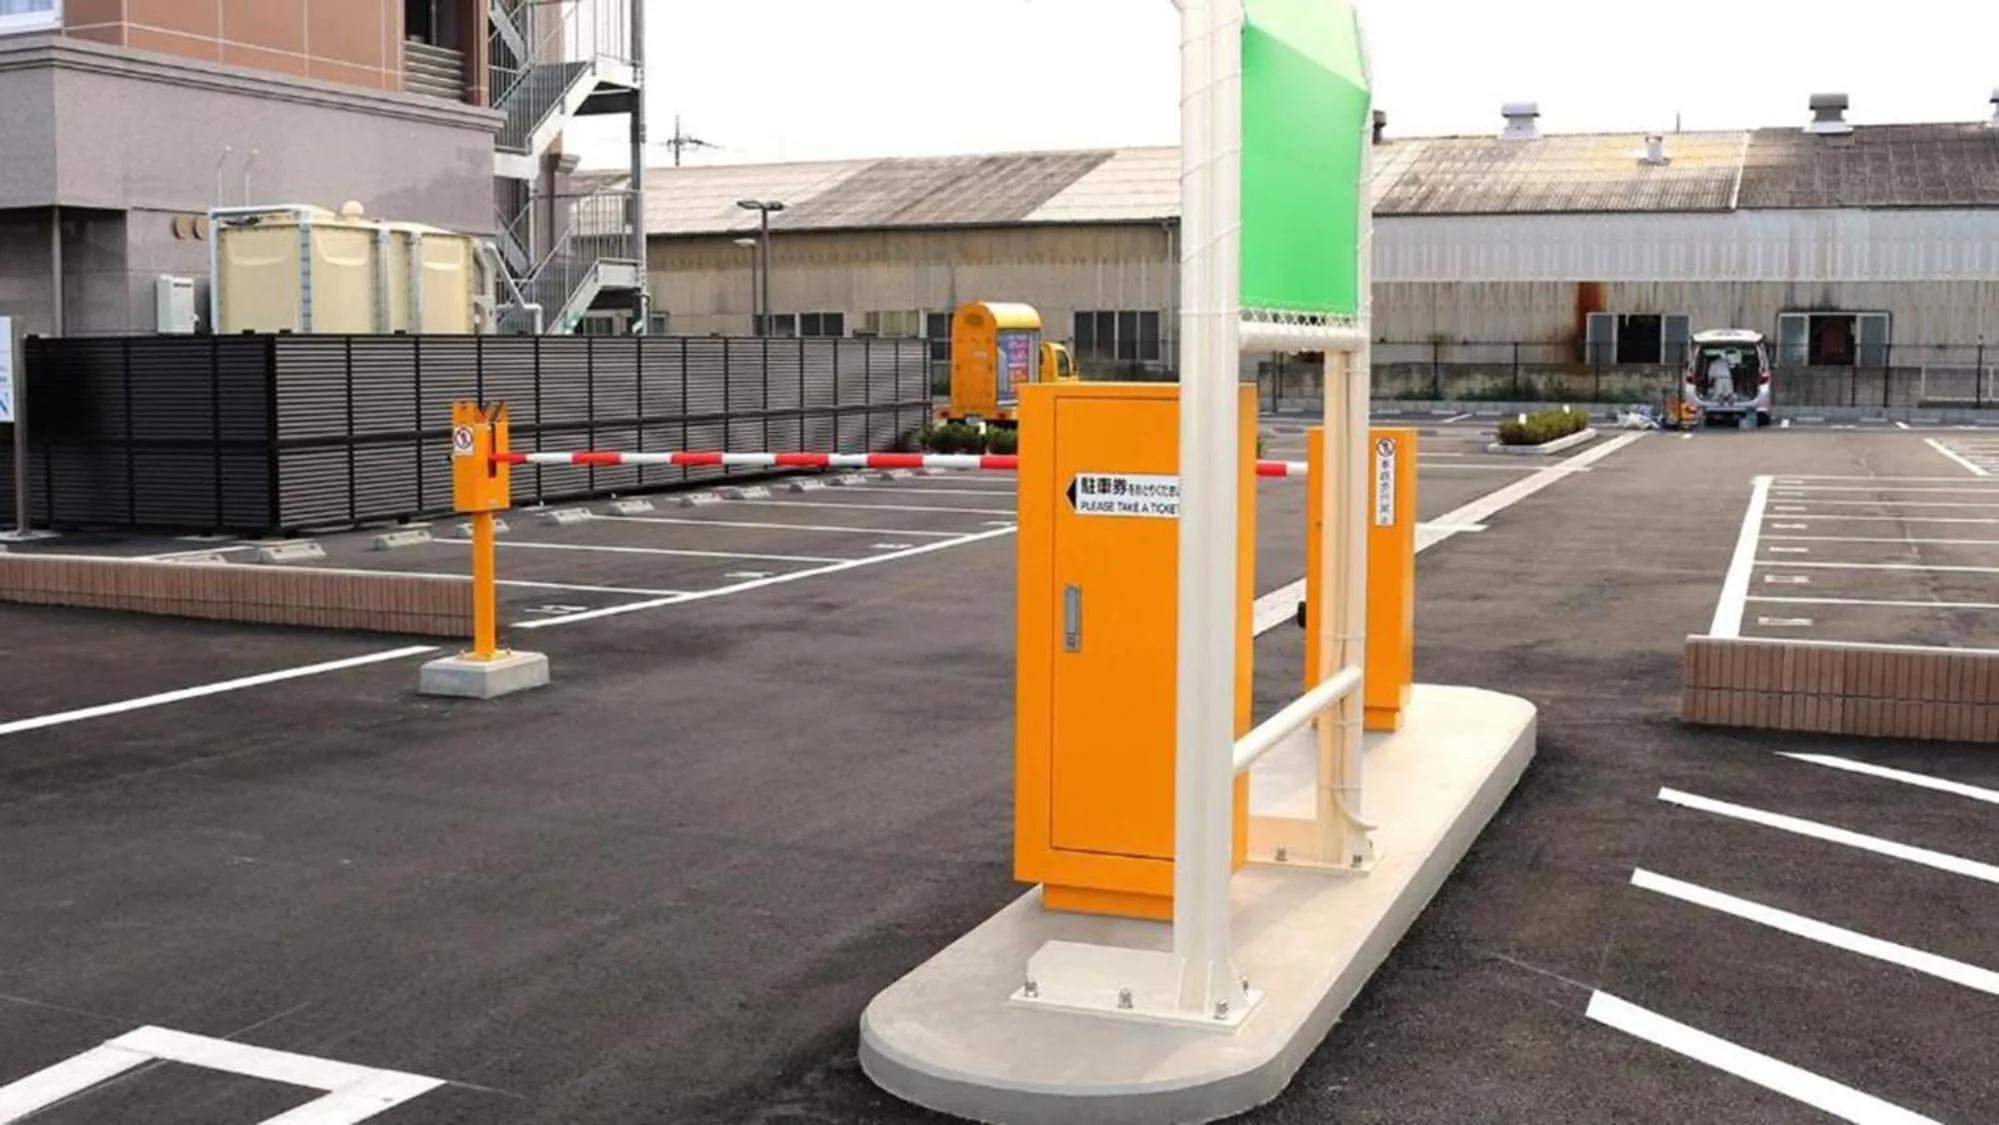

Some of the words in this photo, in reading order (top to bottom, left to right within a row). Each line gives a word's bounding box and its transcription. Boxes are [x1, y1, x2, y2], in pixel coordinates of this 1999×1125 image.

[1080, 501, 1115, 512] PLEASE
[1117, 502, 1139, 513] TAKE
[1141, 504, 1149, 513] A
